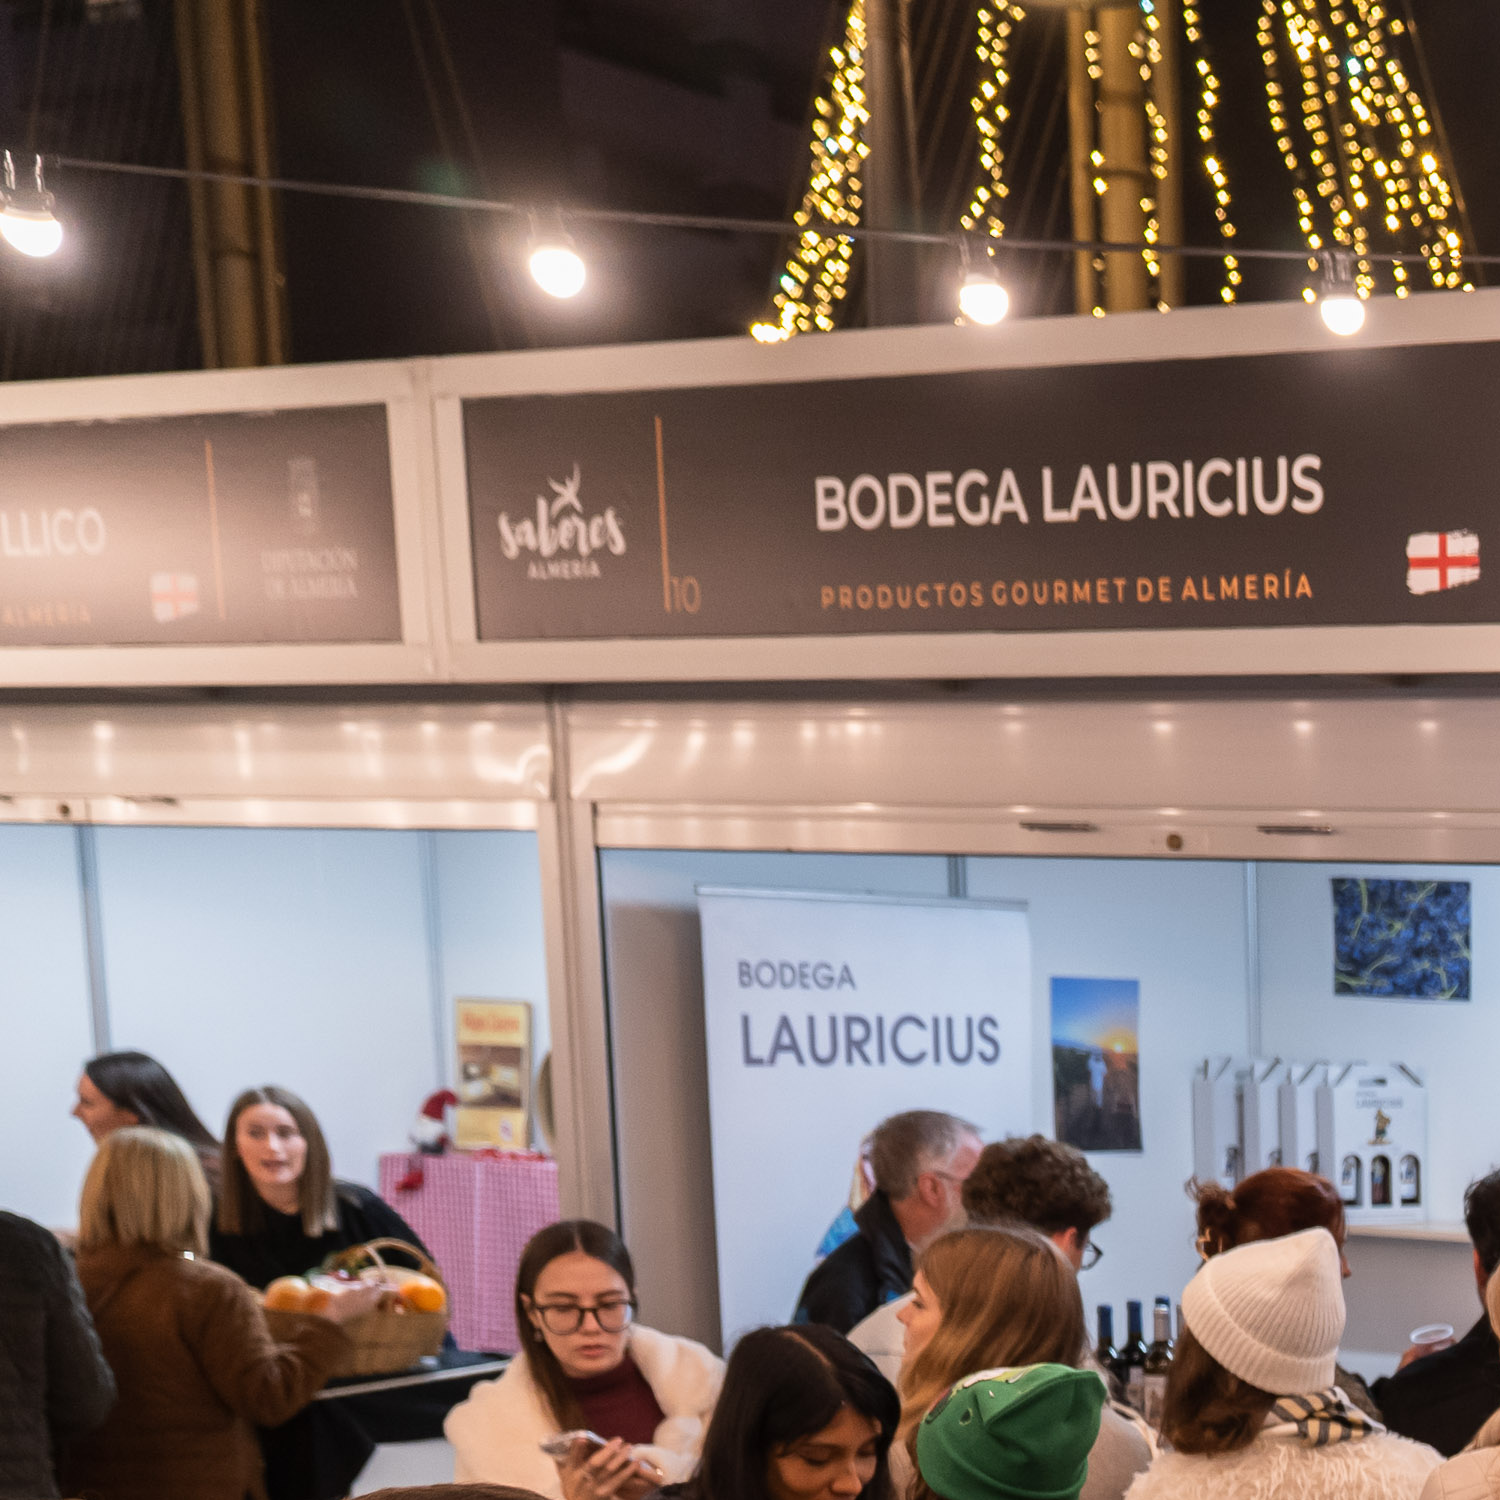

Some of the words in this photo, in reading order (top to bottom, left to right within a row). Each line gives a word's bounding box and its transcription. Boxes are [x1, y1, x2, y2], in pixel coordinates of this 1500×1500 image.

[815, 470, 1028, 532] BODEGA
[1042, 454, 1324, 523] LAURICIUS
[498, 495, 627, 560] sabores
[671, 575, 702, 614] 10
[820, 581, 984, 611] PRODUCTOS
[991, 576, 1126, 606] GOURMET
[1136, 576, 1172, 603] DE
[1181, 569, 1314, 601] ALMERÍA
[737, 959, 857, 990] BODEGA
[741, 1013, 1001, 1067] LAURICIUS
